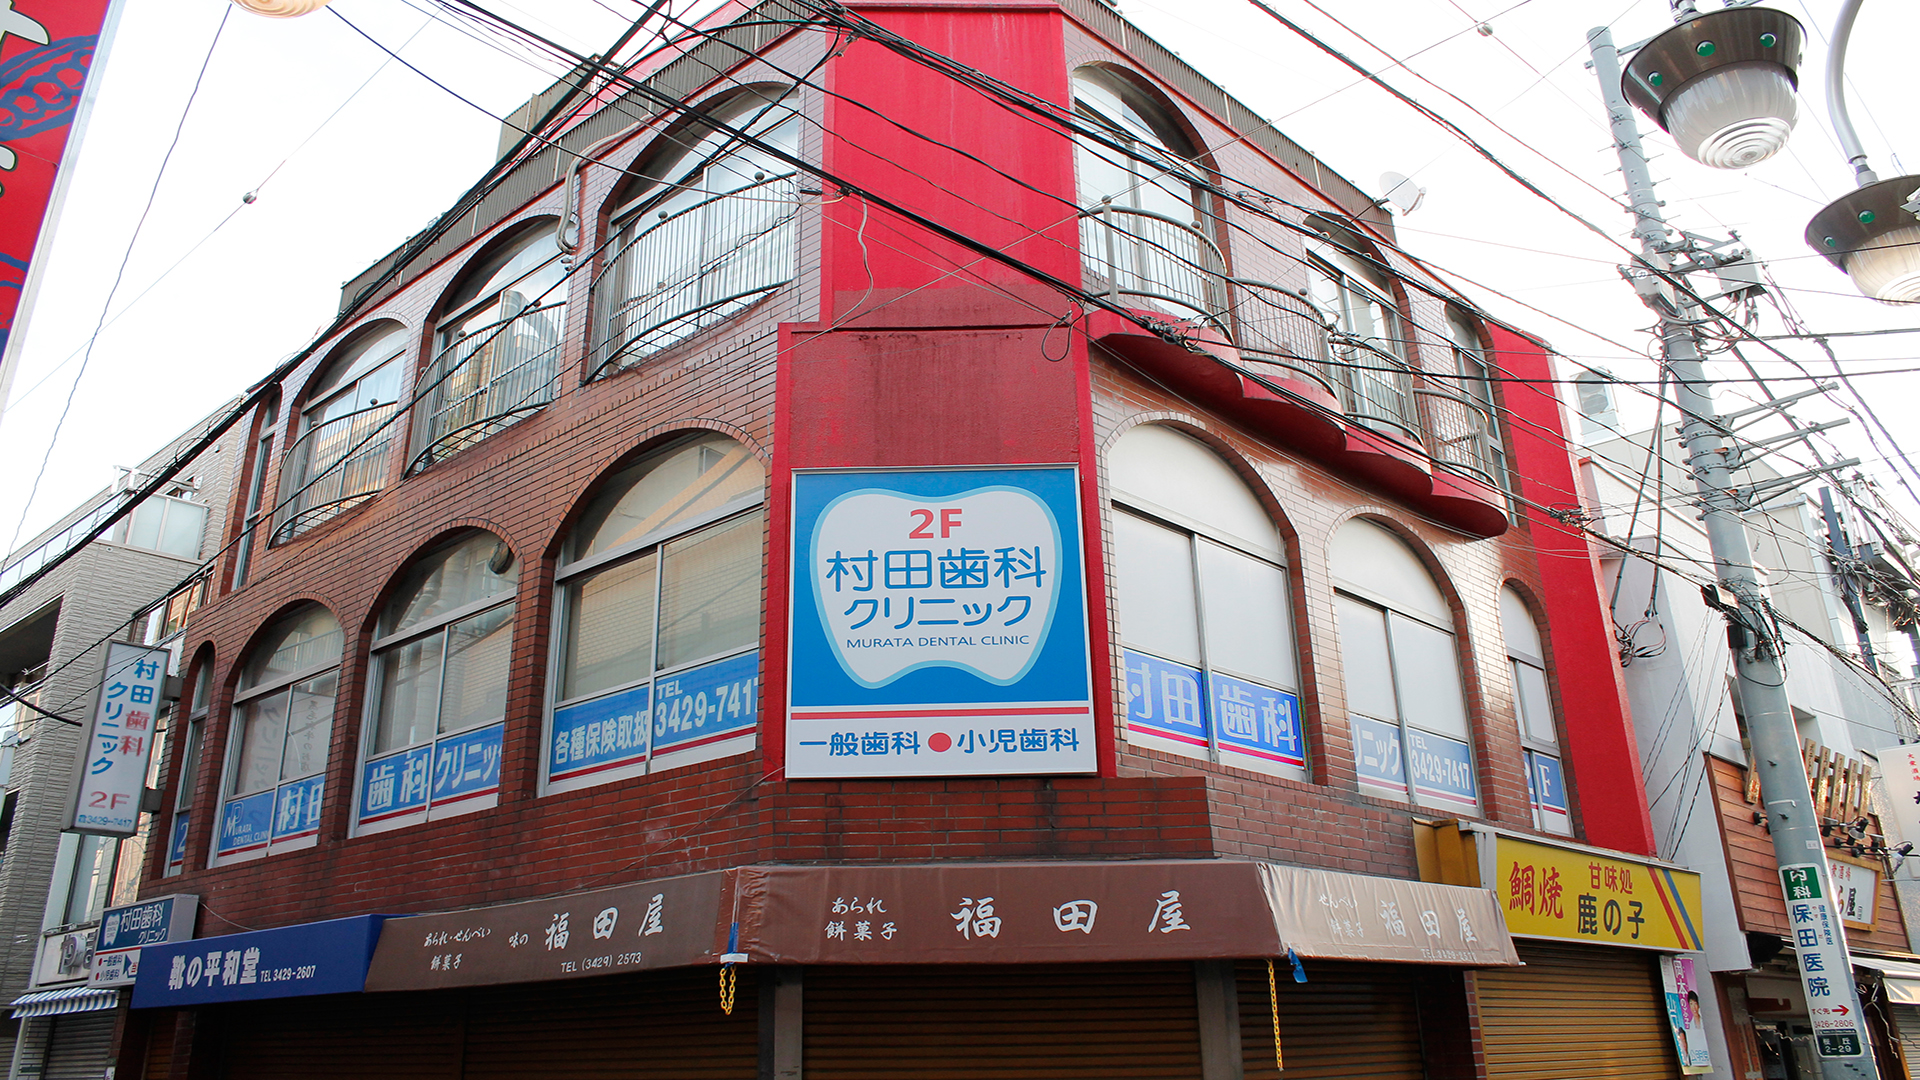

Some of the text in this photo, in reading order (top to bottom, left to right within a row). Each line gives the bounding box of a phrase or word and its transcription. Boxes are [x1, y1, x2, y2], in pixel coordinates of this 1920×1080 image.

[908, 508, 963, 539] 2F
[826, 545, 1047, 592] 村田歯科
[844, 595, 1032, 630] クリニック
[846, 635, 1030, 649] MURATA DENTAL CLINIC
[656, 679, 683, 700] TEL
[118, 658, 160, 758] 村田歯科
[91, 681, 129, 776] クリニック
[799, 727, 1080, 757] 一般歯科 小児歯科
[1409, 733, 1428, 750] TEL
[1411, 749, 1471, 790] 3429-7417
[88, 790, 131, 810] 2F
[1508, 860, 1634, 920] 鯛焼 甘味処
[1789, 869, 1812, 899] 内科
[120, 902, 165, 933] 村田歯科
[831, 896, 888, 915] あられ
[950, 889, 1192, 941] 福田屋
[1577, 892, 1645, 940] 鹿の子
[138, 928, 167, 944] クリニック
[508, 931, 529, 949] 味の
[545, 893, 665, 951] 福田屋
[560, 951, 642, 973] TEL (3429) 2573
[1792, 903, 1831, 998] 保田医院
[168, 946, 261, 991] 靴の平和堂
[260, 965, 317, 983] TEL 3429-2607
[1824, 1045, 1852, 1053] 2-29
